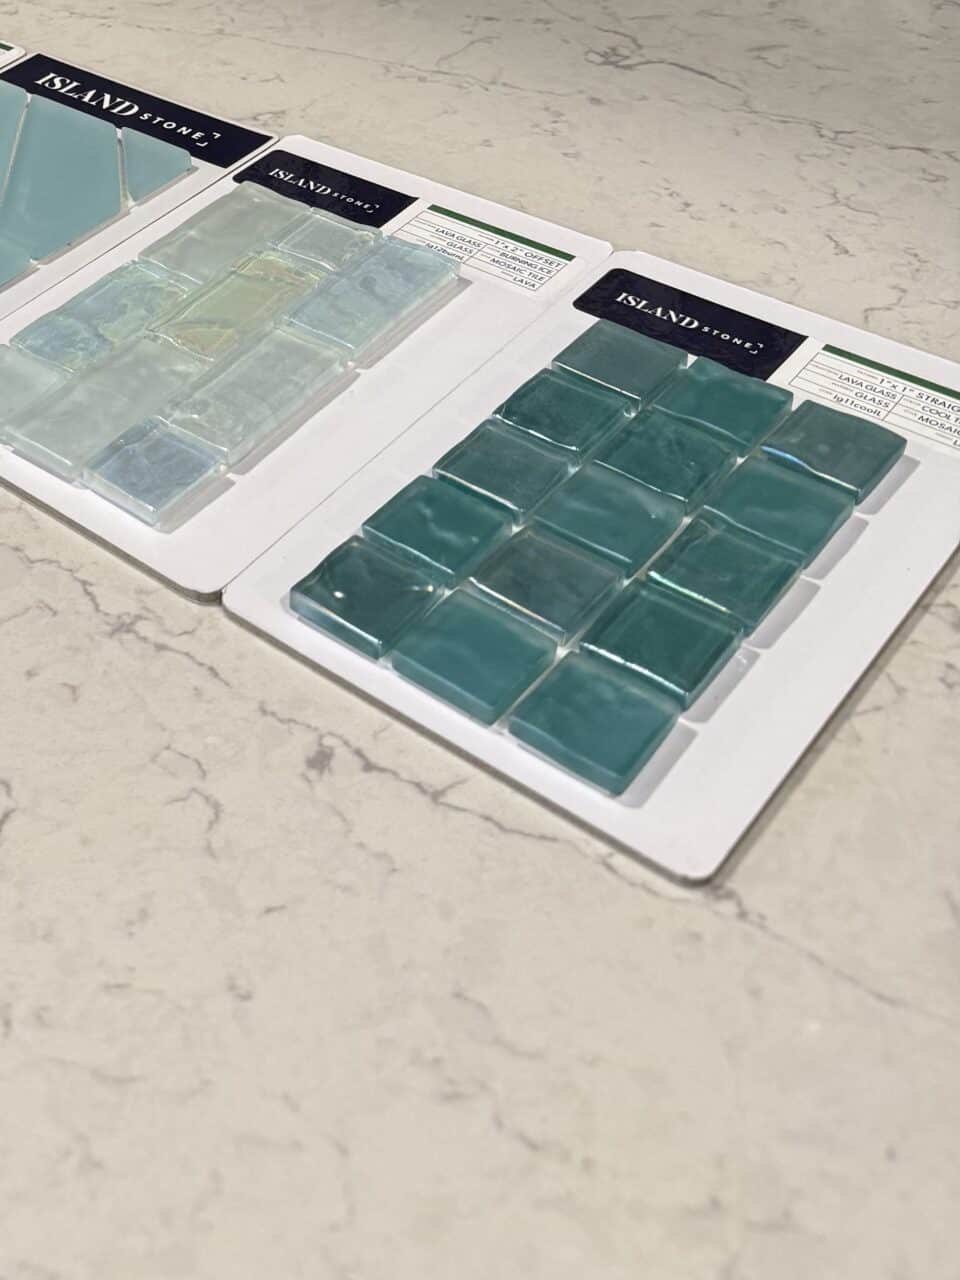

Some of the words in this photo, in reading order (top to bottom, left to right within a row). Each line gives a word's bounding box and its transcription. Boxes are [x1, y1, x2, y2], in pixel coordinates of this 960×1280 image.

[34, 72, 140, 116] ISLAND
[139, 112, 206, 141] STONE
[268, 168, 332, 195] ISLAND
[332, 192, 372, 209] STONE
[435, 227, 456, 238] LAVA
[489, 257, 528, 274] MOSAIC
[527, 271, 546, 281] TILE
[499, 251, 538, 269] BURNING
[539, 266, 555, 275] ICE
[524, 251, 562, 268] OFFSET
[513, 276, 537, 289] LAVA
[615, 292, 699, 329] ISLAND
[701, 326, 754, 349] STONE
[838, 374, 864, 388] LAVA
[864, 384, 898, 401] GLASS
[854, 391, 890, 408] GLASS
[921, 404, 953, 421] COOL
